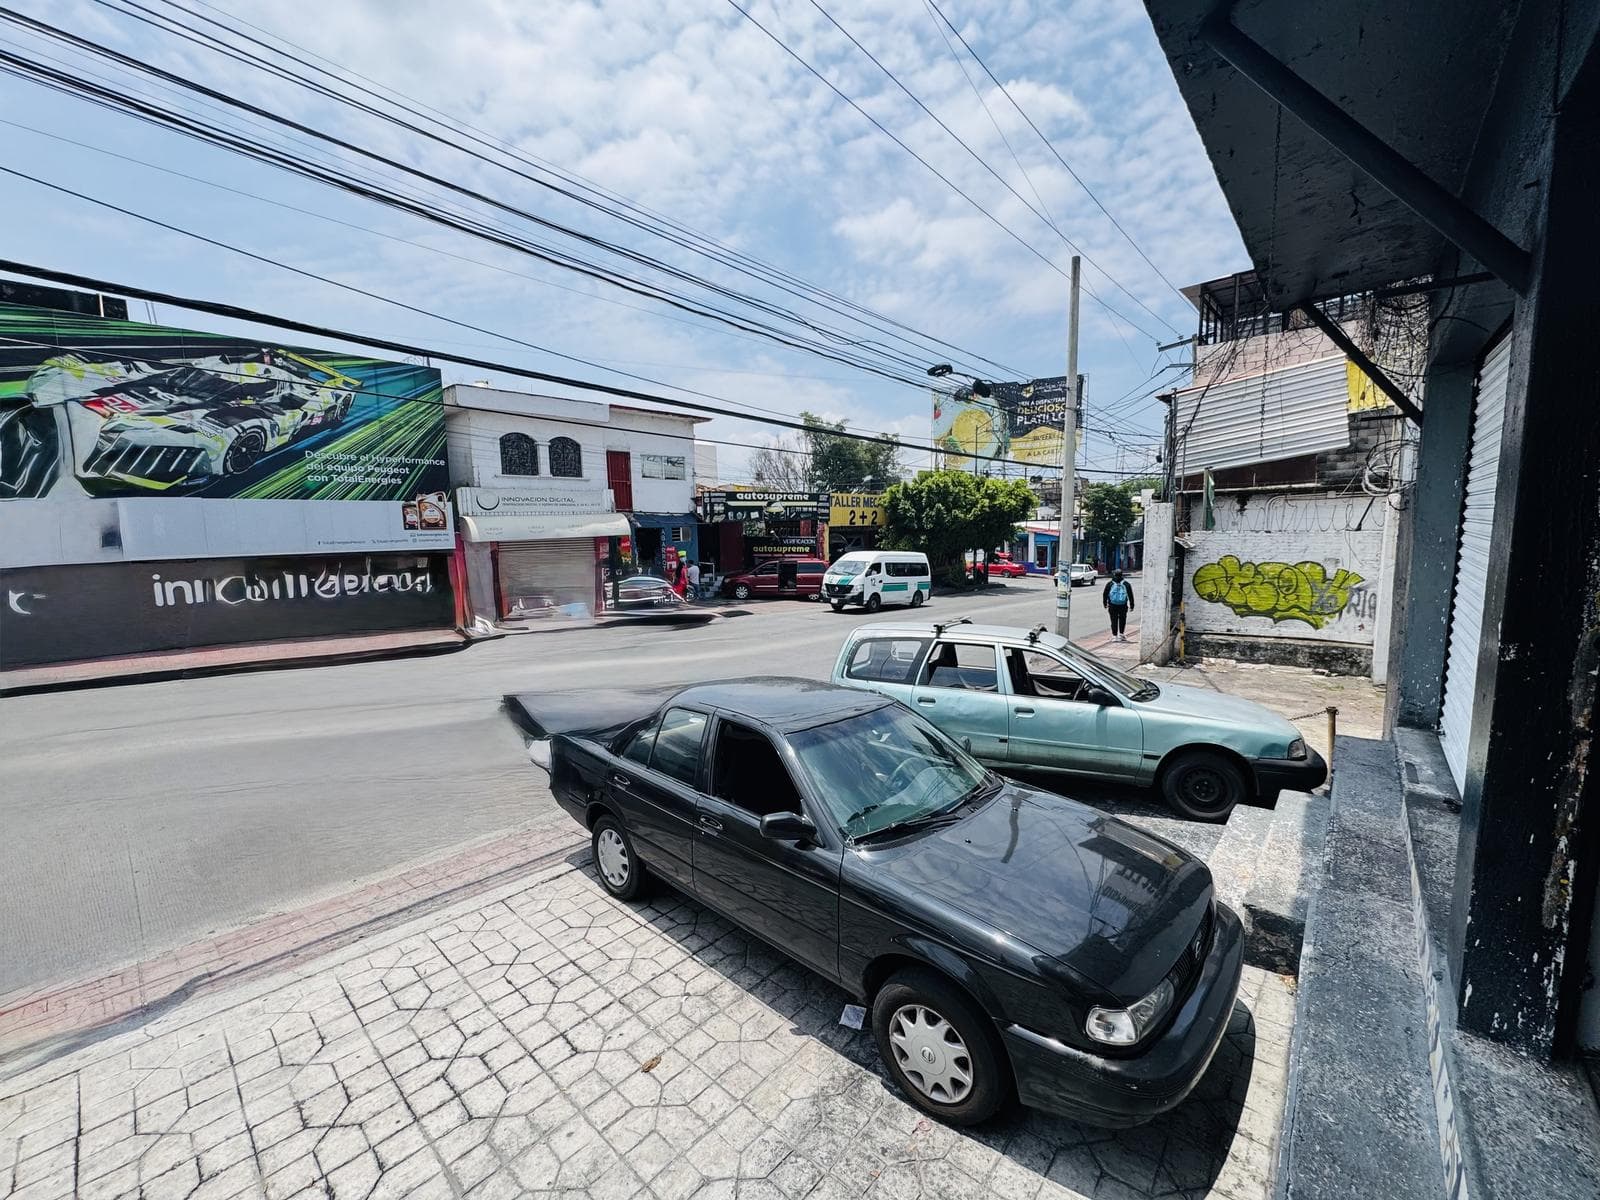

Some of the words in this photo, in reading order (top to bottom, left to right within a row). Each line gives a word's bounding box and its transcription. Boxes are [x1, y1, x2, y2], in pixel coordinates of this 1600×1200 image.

[305, 450, 357, 462] Descubre
[359, 454, 369, 462] el
[371, 455, 446, 467] Hyperformance
[305, 463, 324, 471] del
[326, 464, 365, 474] equipo
[367, 464, 410, 475] Peugeot
[307, 474, 329, 483] con
[331, 474, 402, 486] TotalEnergies
[736, 492, 810, 501] autosupreme
[831, 495, 861, 507] TALLER
[849, 509, 856, 525] 2
[871, 510, 878, 525] 2
[753, 545, 810, 554] autosupreme
